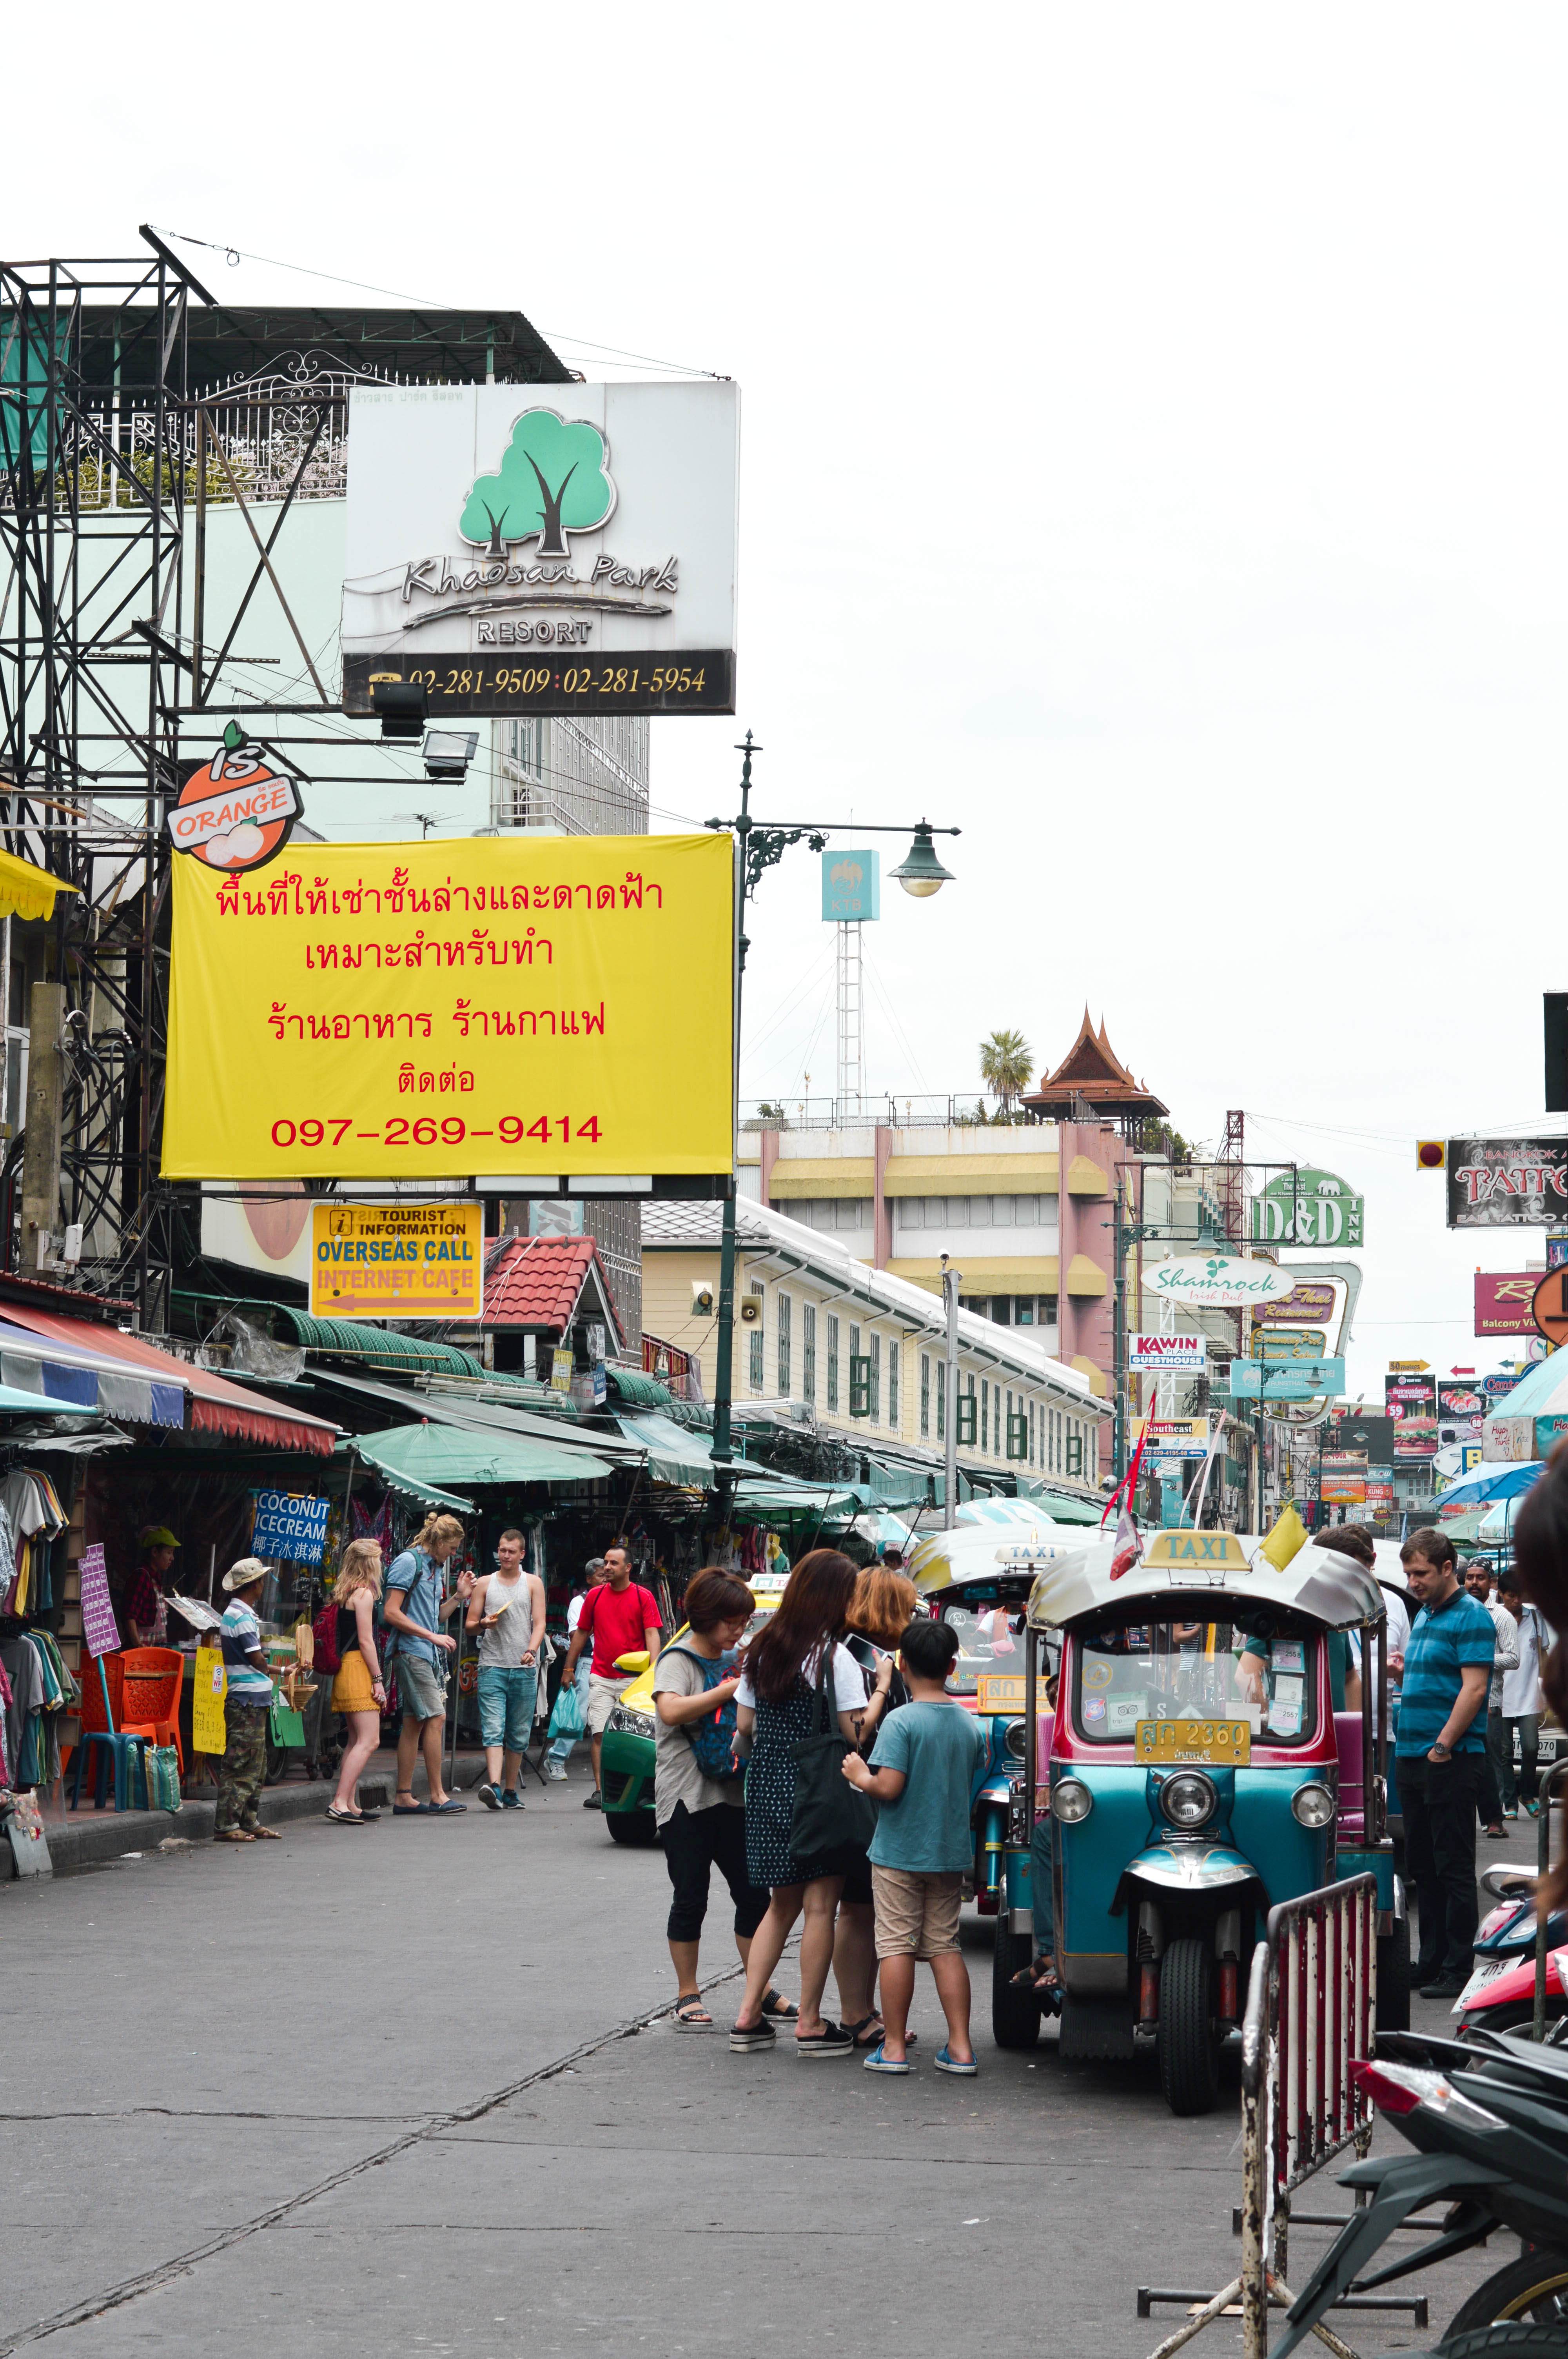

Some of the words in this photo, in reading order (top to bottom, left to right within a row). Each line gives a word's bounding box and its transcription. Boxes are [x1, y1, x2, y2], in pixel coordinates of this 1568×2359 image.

[401, 554, 578, 603] Khaosan
[591, 553, 679, 593] Park
[476, 620, 592, 643] RESORT
[176, 787, 287, 836] ORANGE
[831, 898, 862, 912] KTB
[306, 927, 552, 969] เหมาะสำหรับทำ
[268, 1002, 432, 1039] ร้านอาหาร
[452, 998, 604, 1036] ร้านกาแฟ
[399, 1062, 474, 1092] ติดต่อ
[271, 1116, 603, 1147] 097-269-9414
[1485, 1149, 1558, 1160] BANGKOK
[379, 1210, 446, 1221] TOURIST
[1256, 1199, 1343, 1245] D&D
[1493, 1214, 1557, 1223] TATTOO
[360, 1224, 466, 1235] INFORMATION
[318, 1241, 417, 1261] OVERSEAS
[425, 1241, 472, 1260] CALL
[318, 1269, 416, 1288] INTERNET
[423, 1269, 473, 1288] CAFE
[1157, 1269, 1278, 1292] Shamrock
[1190, 1290, 1217, 1301] Irish
[1222, 1291, 1243, 1301] Pub
[1264, 1304, 1323, 1318] Restaurant
[1483, 1320, 1521, 1329] Balcony
[1137, 1337, 1197, 1354] KAWIN
[1254, 1330, 1300, 1348] Swimming
[1300, 1332, 1323, 1346] Pool
[1132, 1356, 1202, 1364] GUESTHOUSE
[1390, 1362, 1400, 1370] 50
[1147, 1424, 1192, 1433] Southeast
[1492, 1425, 1508, 1439] Happy
[258, 1493, 330, 1520] COCONUT
[255, 1513, 326, 1541] ICECREAM
[252, 1534, 322, 1563] 椰子冰淇淋
[1010, 1546, 1055, 1558] TAXI
[1165, 1536, 1229, 1559] TAXI
[1142, 1720, 1175, 1745] สก
[1186, 1723, 1244, 1745] 2360
